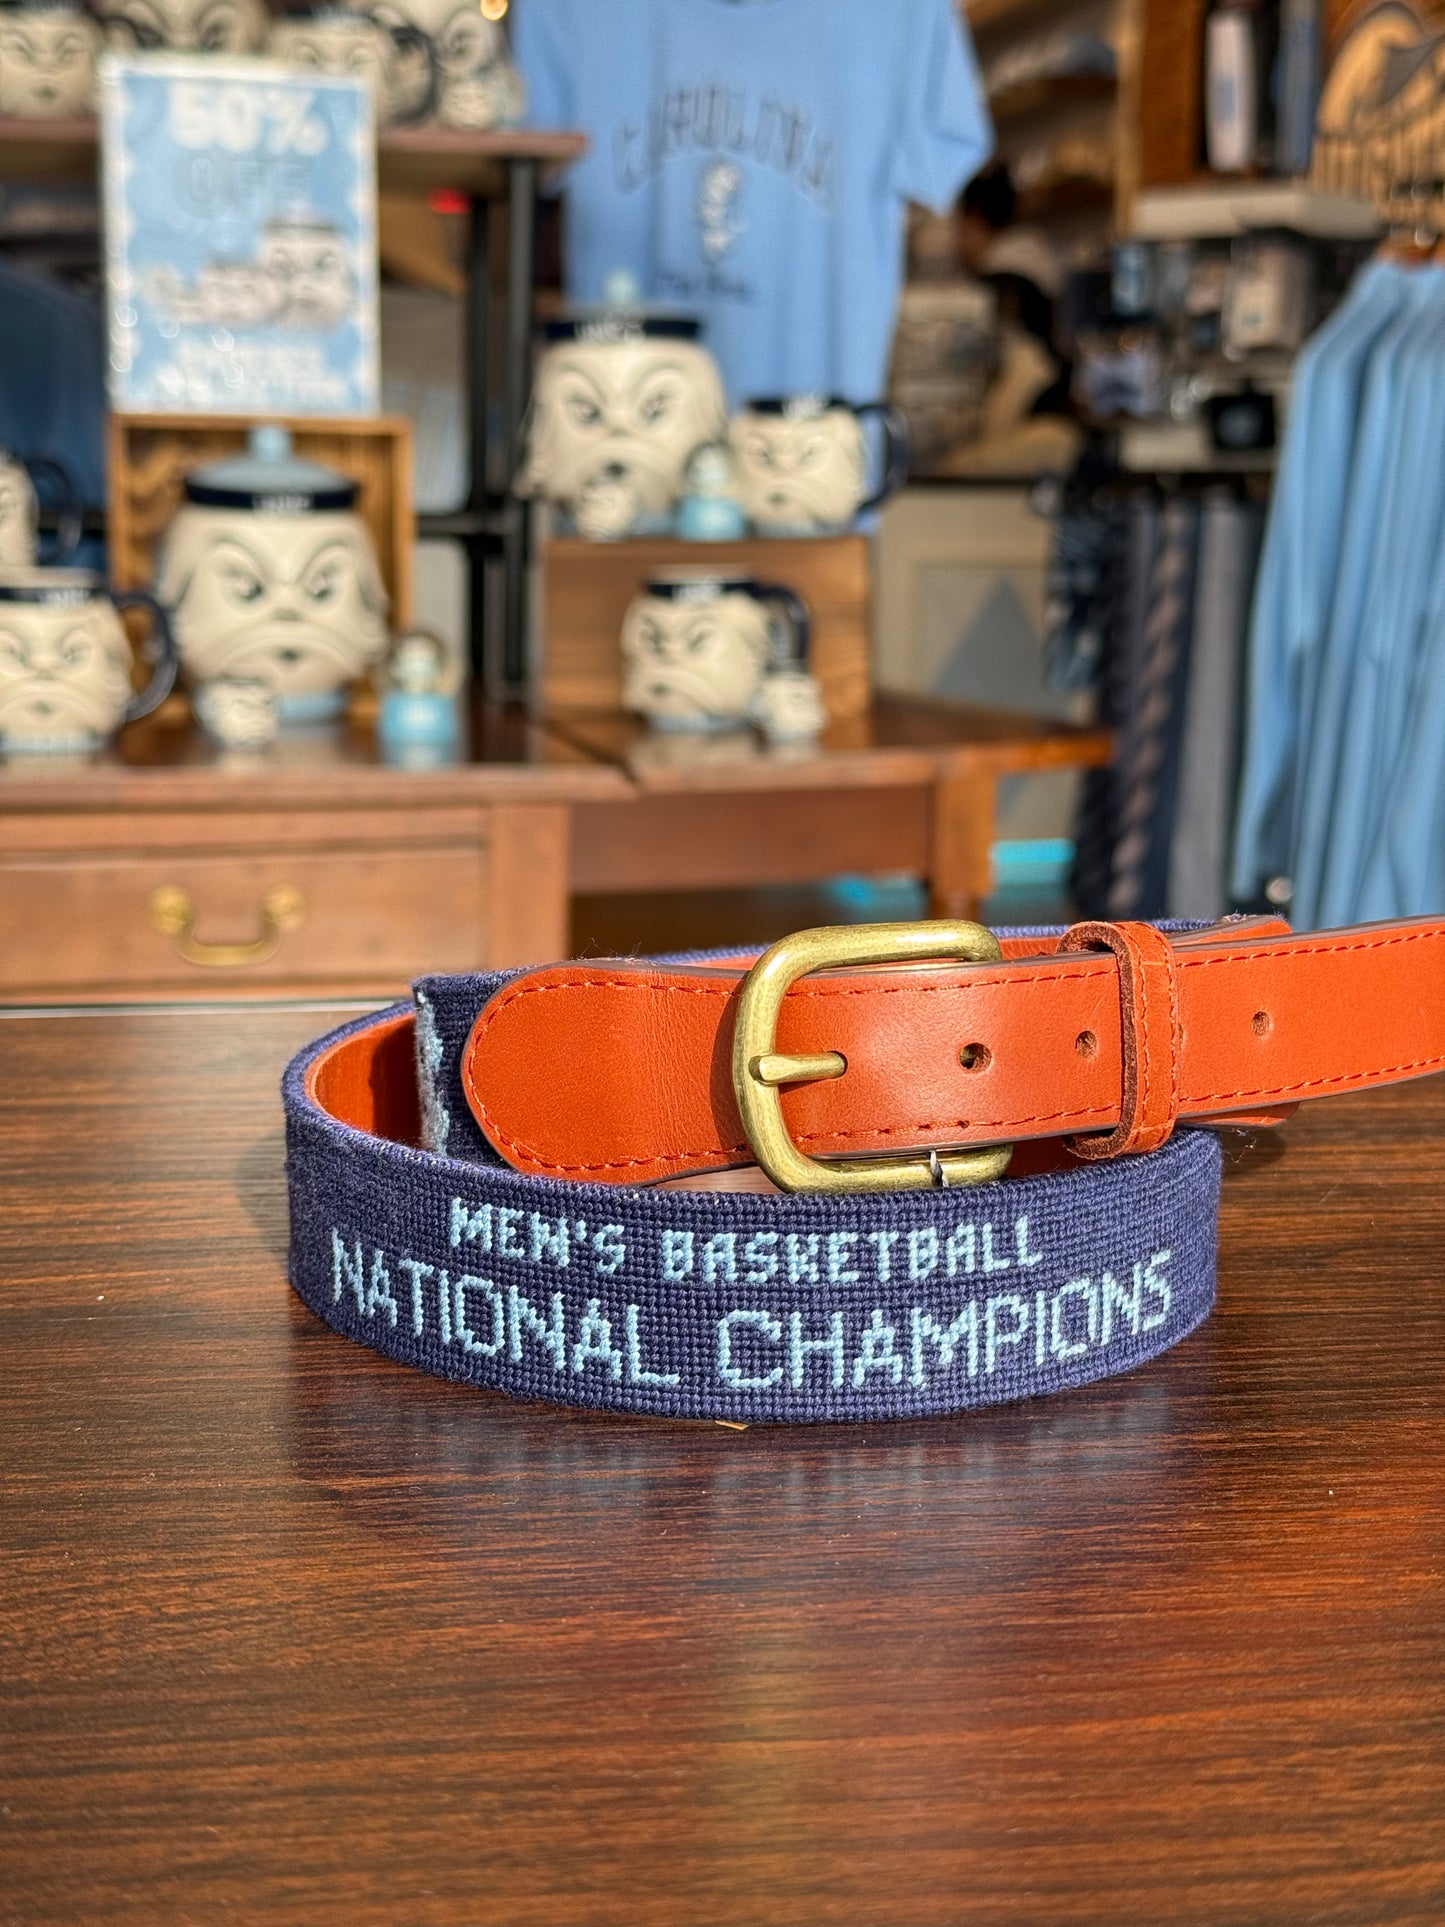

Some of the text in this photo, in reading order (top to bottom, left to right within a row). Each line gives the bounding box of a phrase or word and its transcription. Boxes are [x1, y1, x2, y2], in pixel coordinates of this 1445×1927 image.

[167, 84, 328, 157] 50%
[450, 1196, 1043, 1284] MEN'S BASKETBALL
[333, 1227, 1173, 1390] NATIONAL CHAMPIONS
